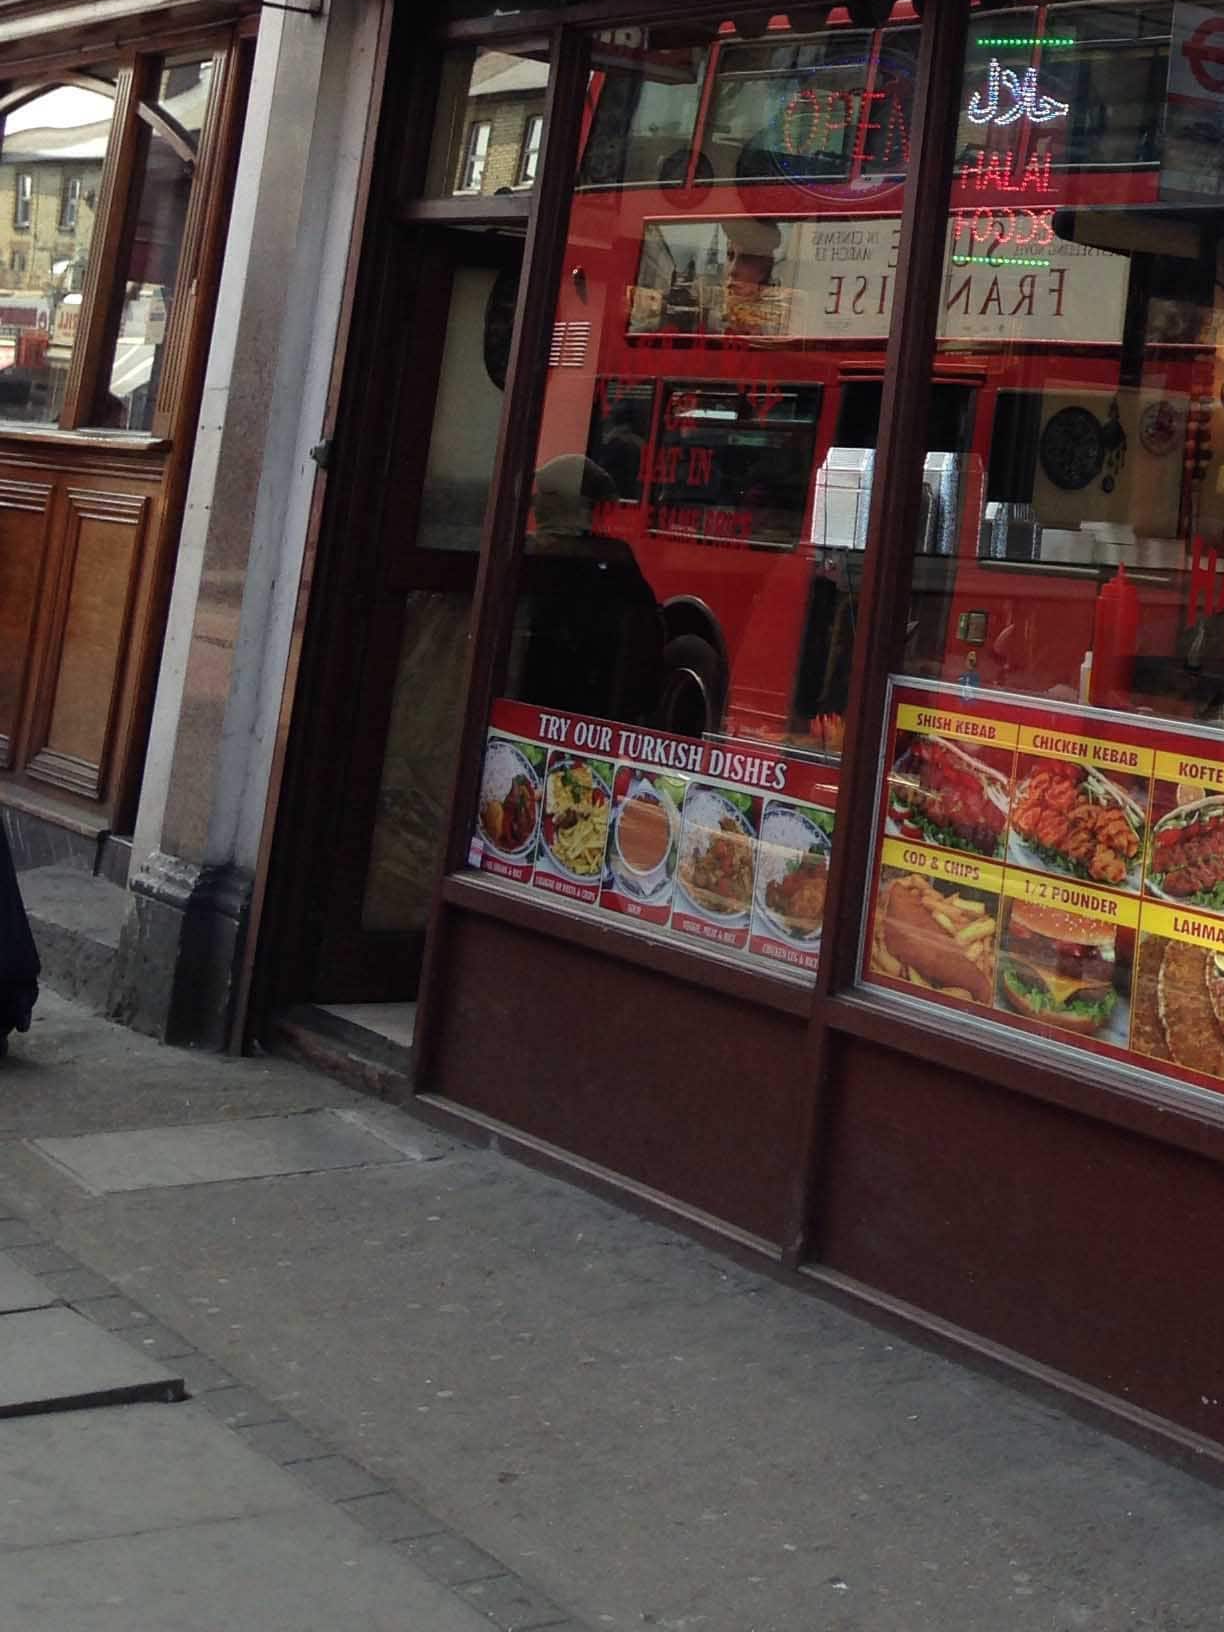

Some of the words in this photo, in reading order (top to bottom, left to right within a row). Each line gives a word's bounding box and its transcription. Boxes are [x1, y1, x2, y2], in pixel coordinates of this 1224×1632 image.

[968, 56, 1070, 125] حلال
[916, 712, 953, 732] SHISH
[955, 719, 997, 740] KEBAB
[538, 713, 569, 740] TRY
[573, 721, 611, 753] OUR
[618, 730, 703, 772] TURKISH
[709, 752, 788, 791] DISHES
[1032, 734, 1089, 758] CHICKEN
[1093, 745, 1139, 768] KEBAB
[1178, 761, 1224, 784] KOFTE
[902, 849, 928, 867] COD
[930, 855, 941, 870] &
[943, 859, 981, 881] CHIPS
[1051, 887, 1119, 917] POUNDER
